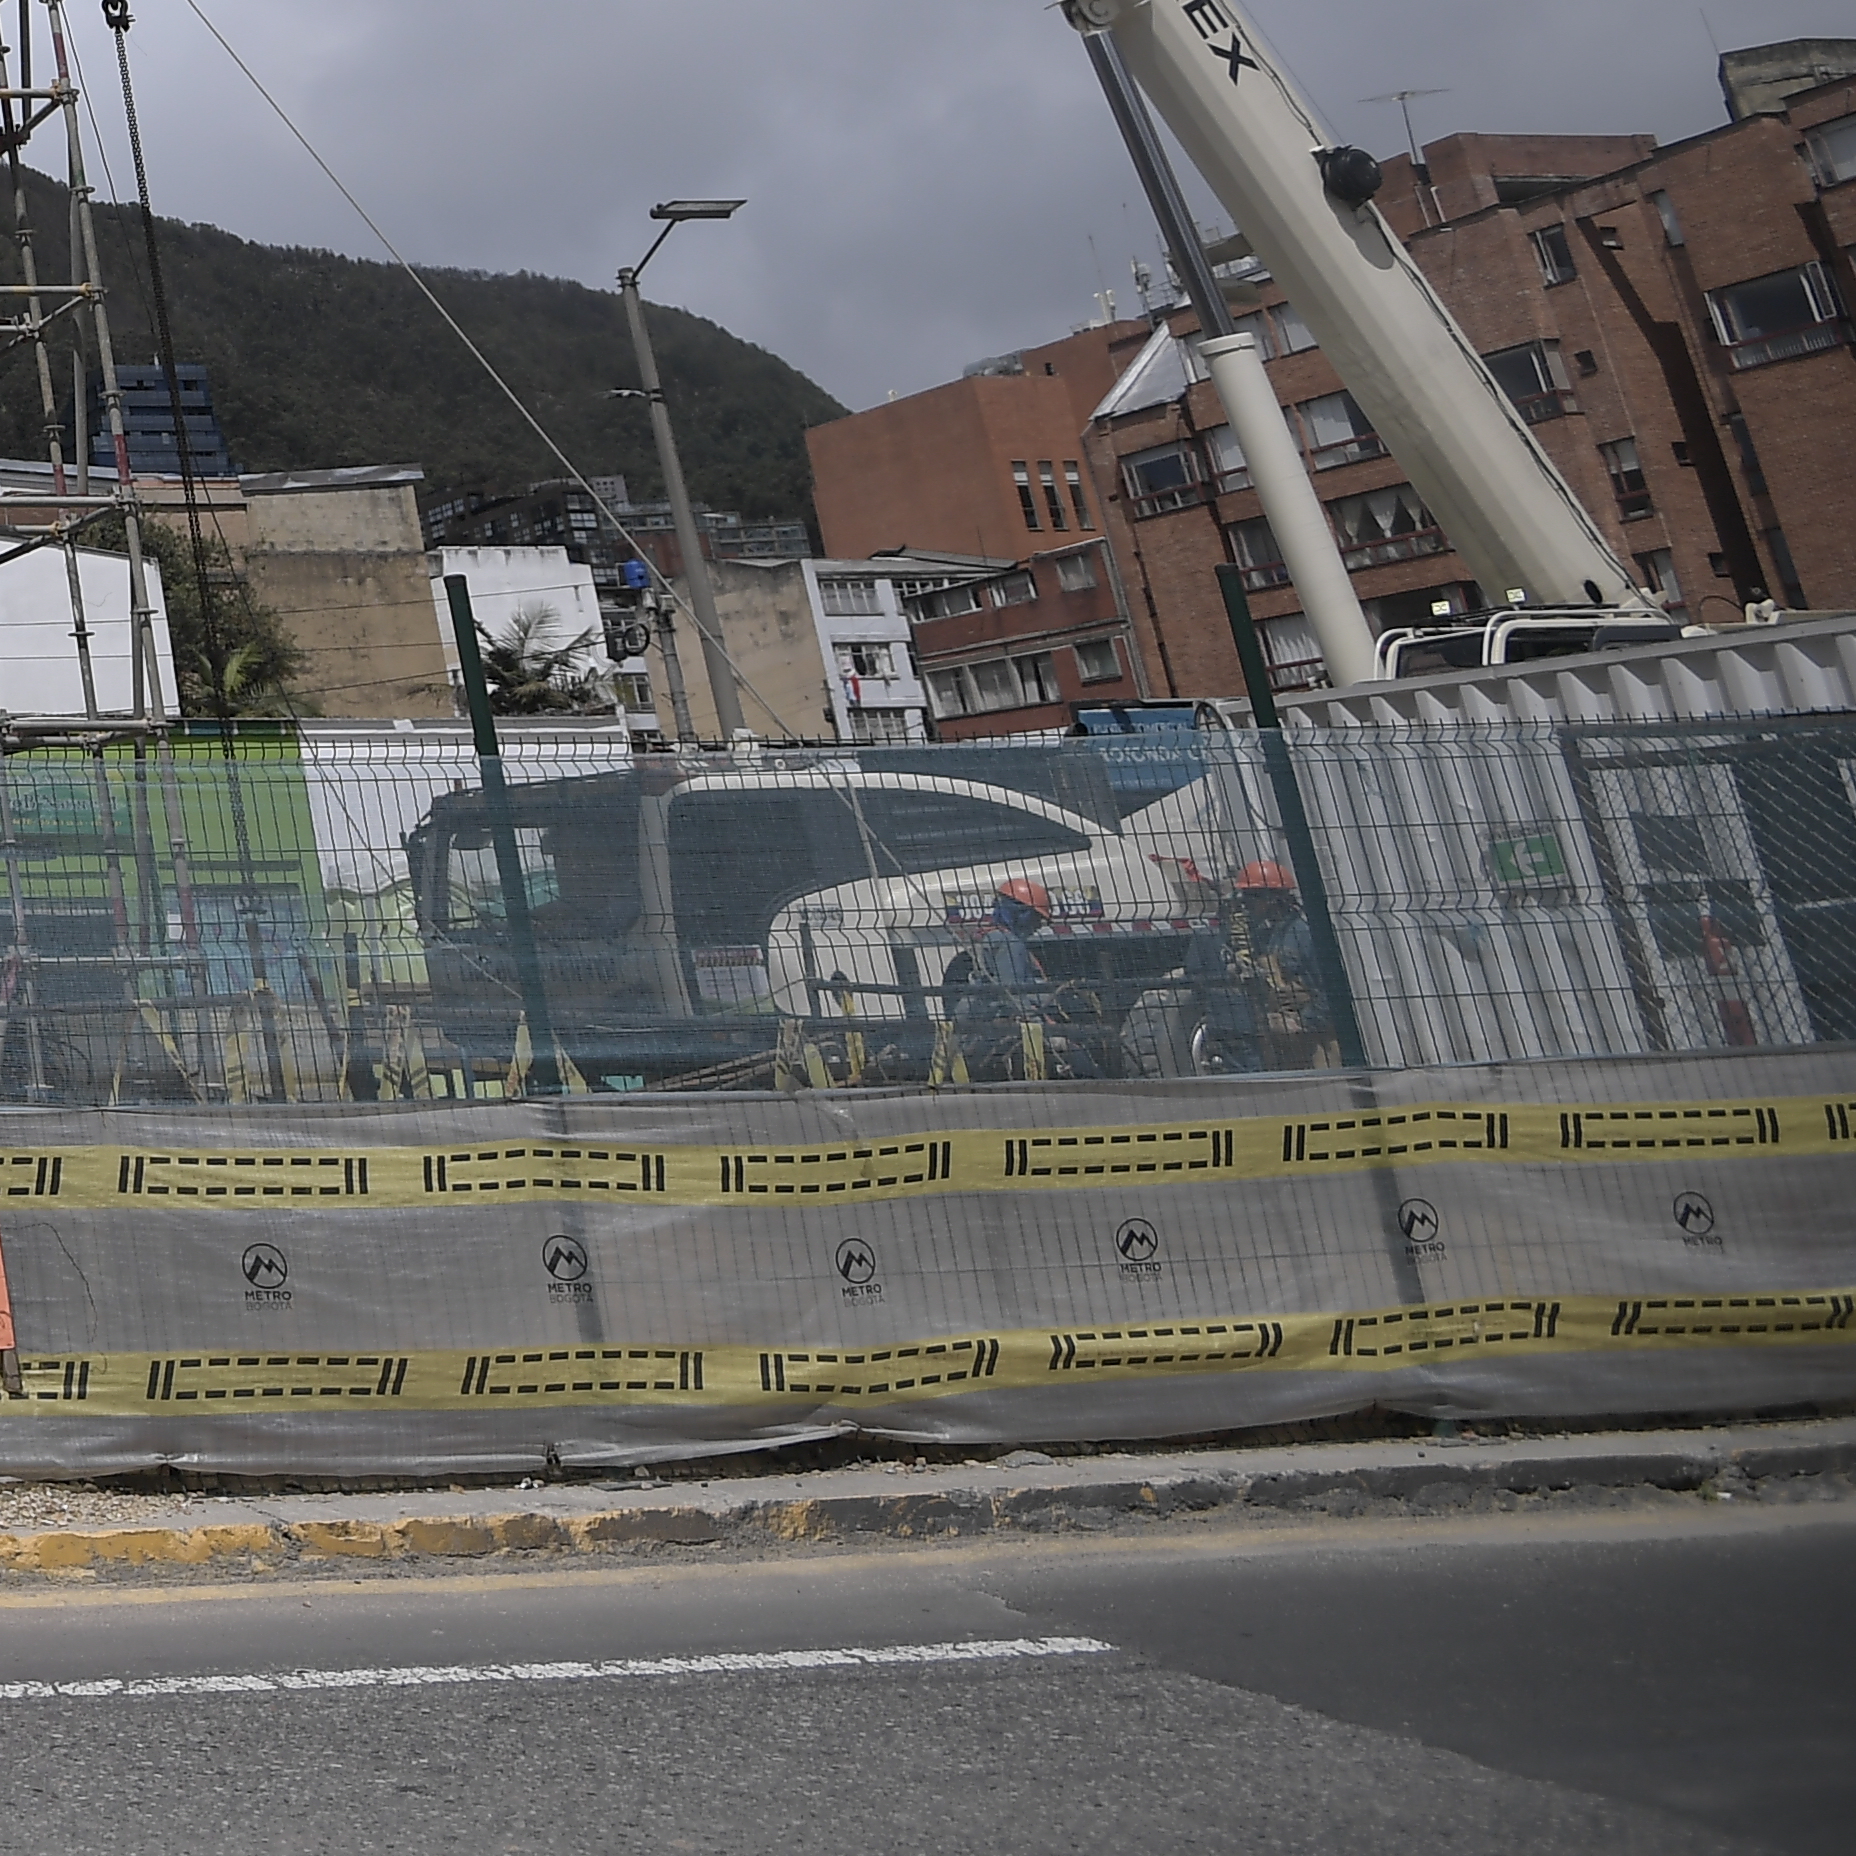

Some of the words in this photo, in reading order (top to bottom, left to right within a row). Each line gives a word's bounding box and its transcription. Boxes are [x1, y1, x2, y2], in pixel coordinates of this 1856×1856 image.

[1405, 1242, 1445, 1255] METRO
[1120, 1262, 1162, 1273] METRO
[548, 1283, 592, 1293] METRO
[842, 1284, 882, 1297] METRO
[245, 1291, 292, 1301] METRO
